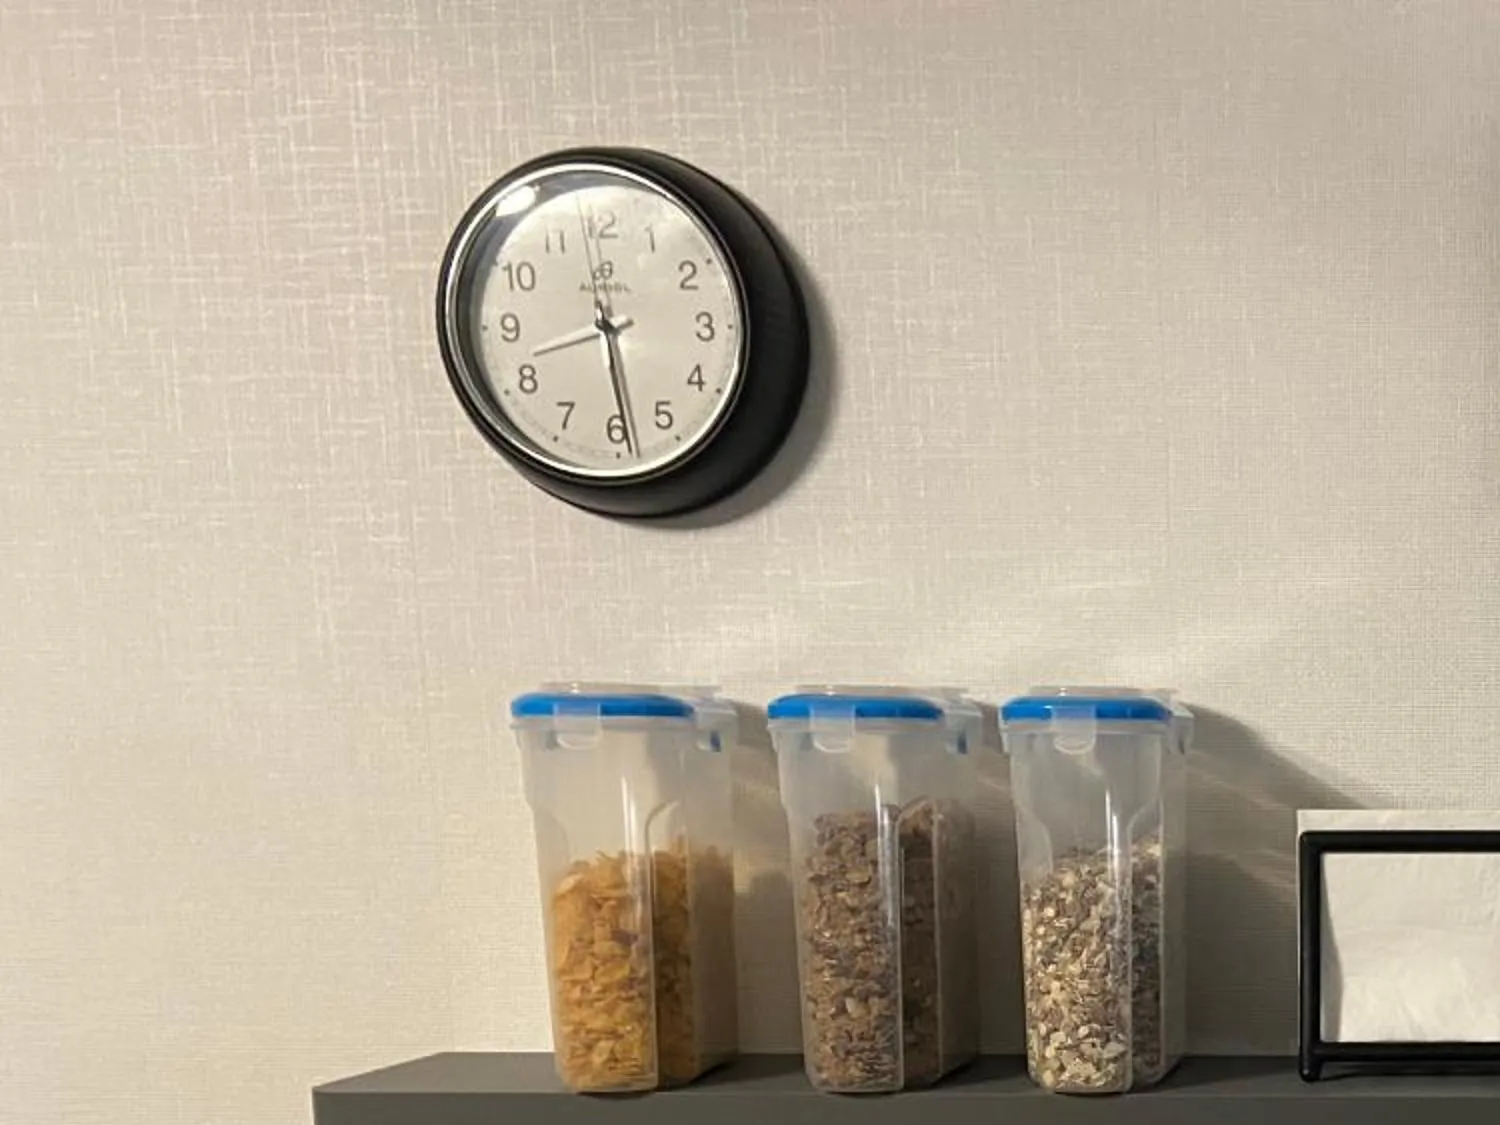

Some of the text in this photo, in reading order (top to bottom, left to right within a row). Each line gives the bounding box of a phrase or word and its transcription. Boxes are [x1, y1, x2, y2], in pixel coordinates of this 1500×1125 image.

[545, 226, 566, 254] 11
[587, 210, 619, 240] 12
[644, 222, 656, 253] 1
[503, 261, 536, 291] 10
[678, 261, 699, 290] 2
[501, 313, 521, 342] 9
[695, 312, 715, 342] 3
[518, 364, 539, 394] 8
[687, 364, 706, 392] 4
[556, 401, 576, 430] 7
[606, 414, 627, 444] 6
[654, 400, 674, 430] 5
